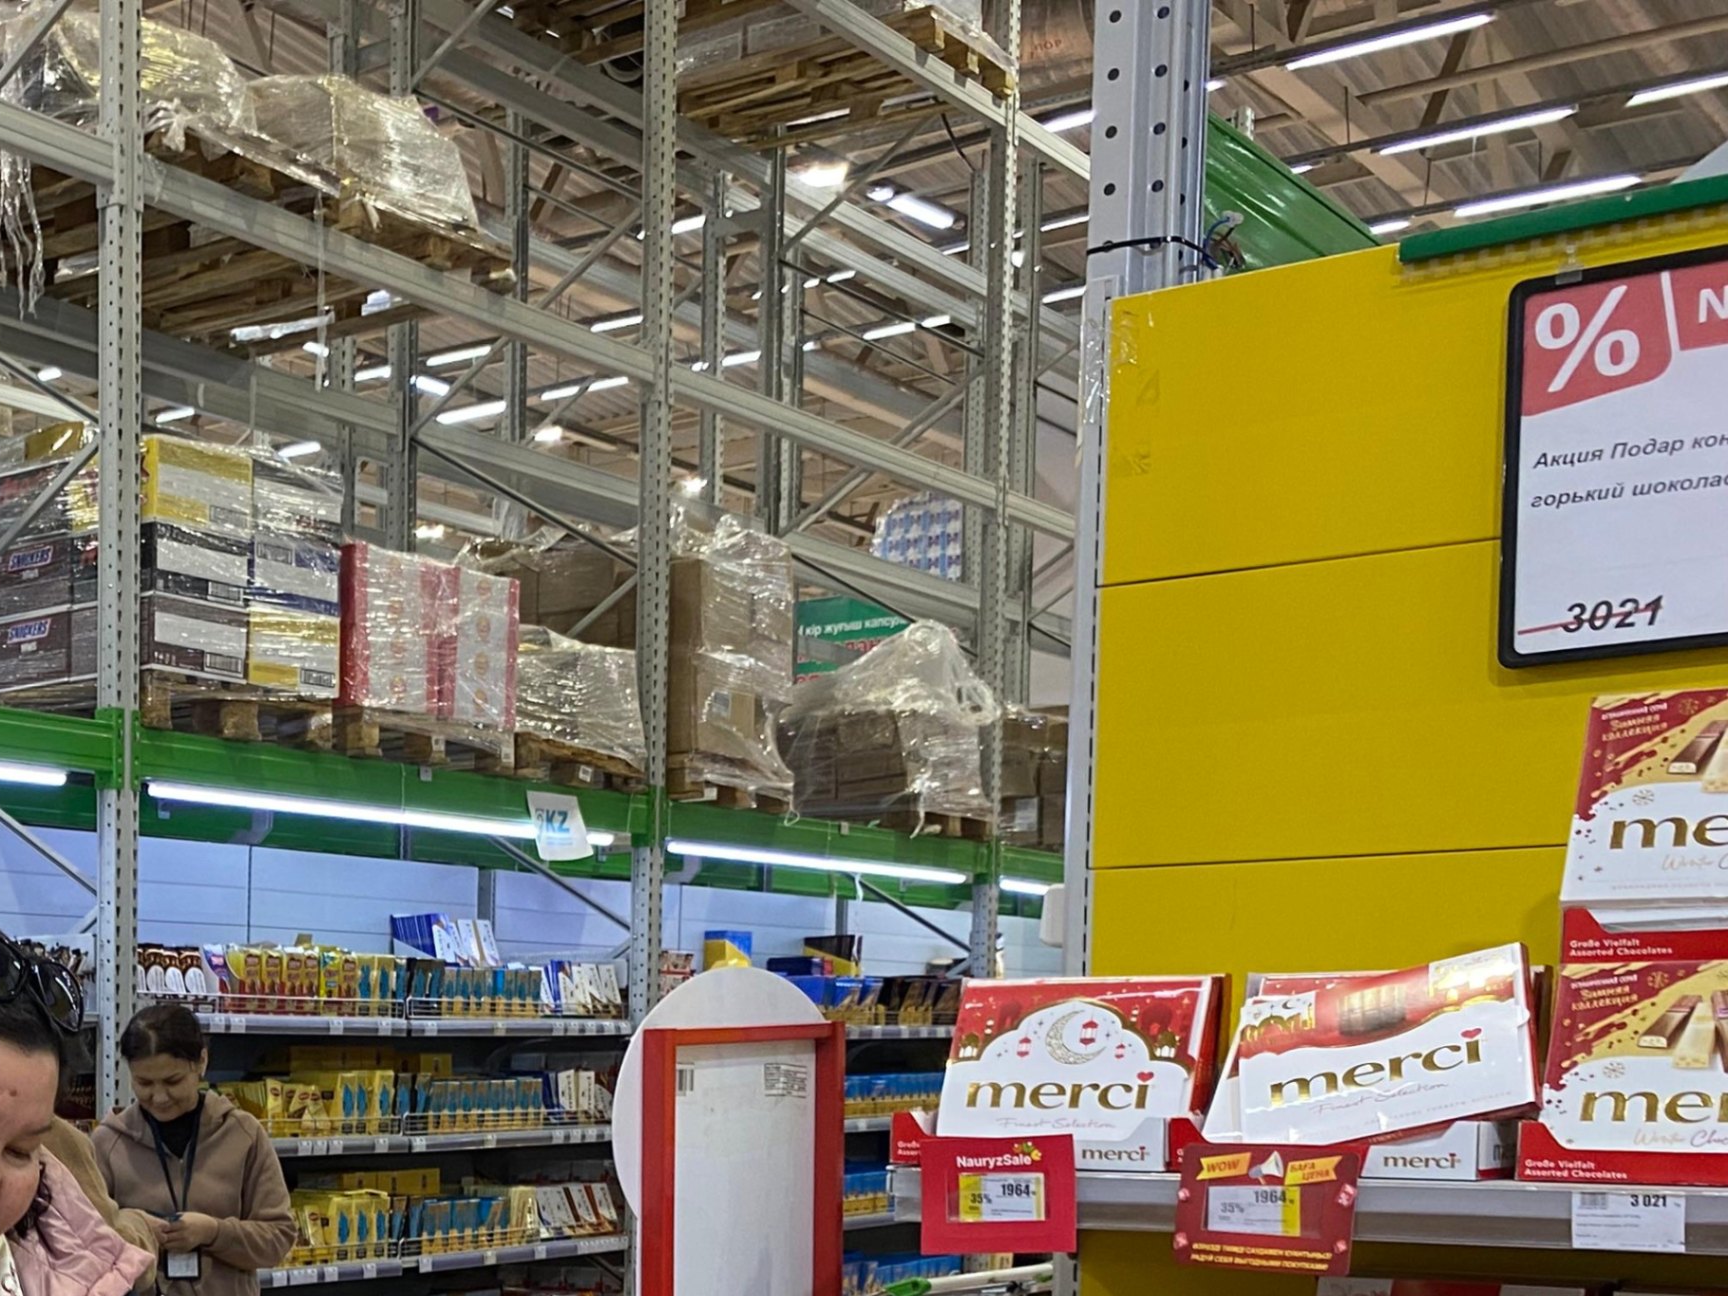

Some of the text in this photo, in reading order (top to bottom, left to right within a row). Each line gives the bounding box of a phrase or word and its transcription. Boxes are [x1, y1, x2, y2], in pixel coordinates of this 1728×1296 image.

[1535, 285, 1640, 392] %
[1533, 446, 1604, 469] Акция
[1611, 437, 1684, 460] Подар
[1531, 482, 1624, 509] горький
[10, 548, 52, 569] SNICKERS
[1561, 596, 1664, 633] 3021
[9, 621, 49, 642] SNICKERS
[1270, 1027, 1483, 1105] merci
[965, 1071, 1154, 1110] merci
[956, 1153, 1032, 1169] NauryzSale
[1081, 1146, 1149, 1162] merci
[1205, 1159, 1240, 1173] WOW
[1383, 1153, 1458, 1169] merci
